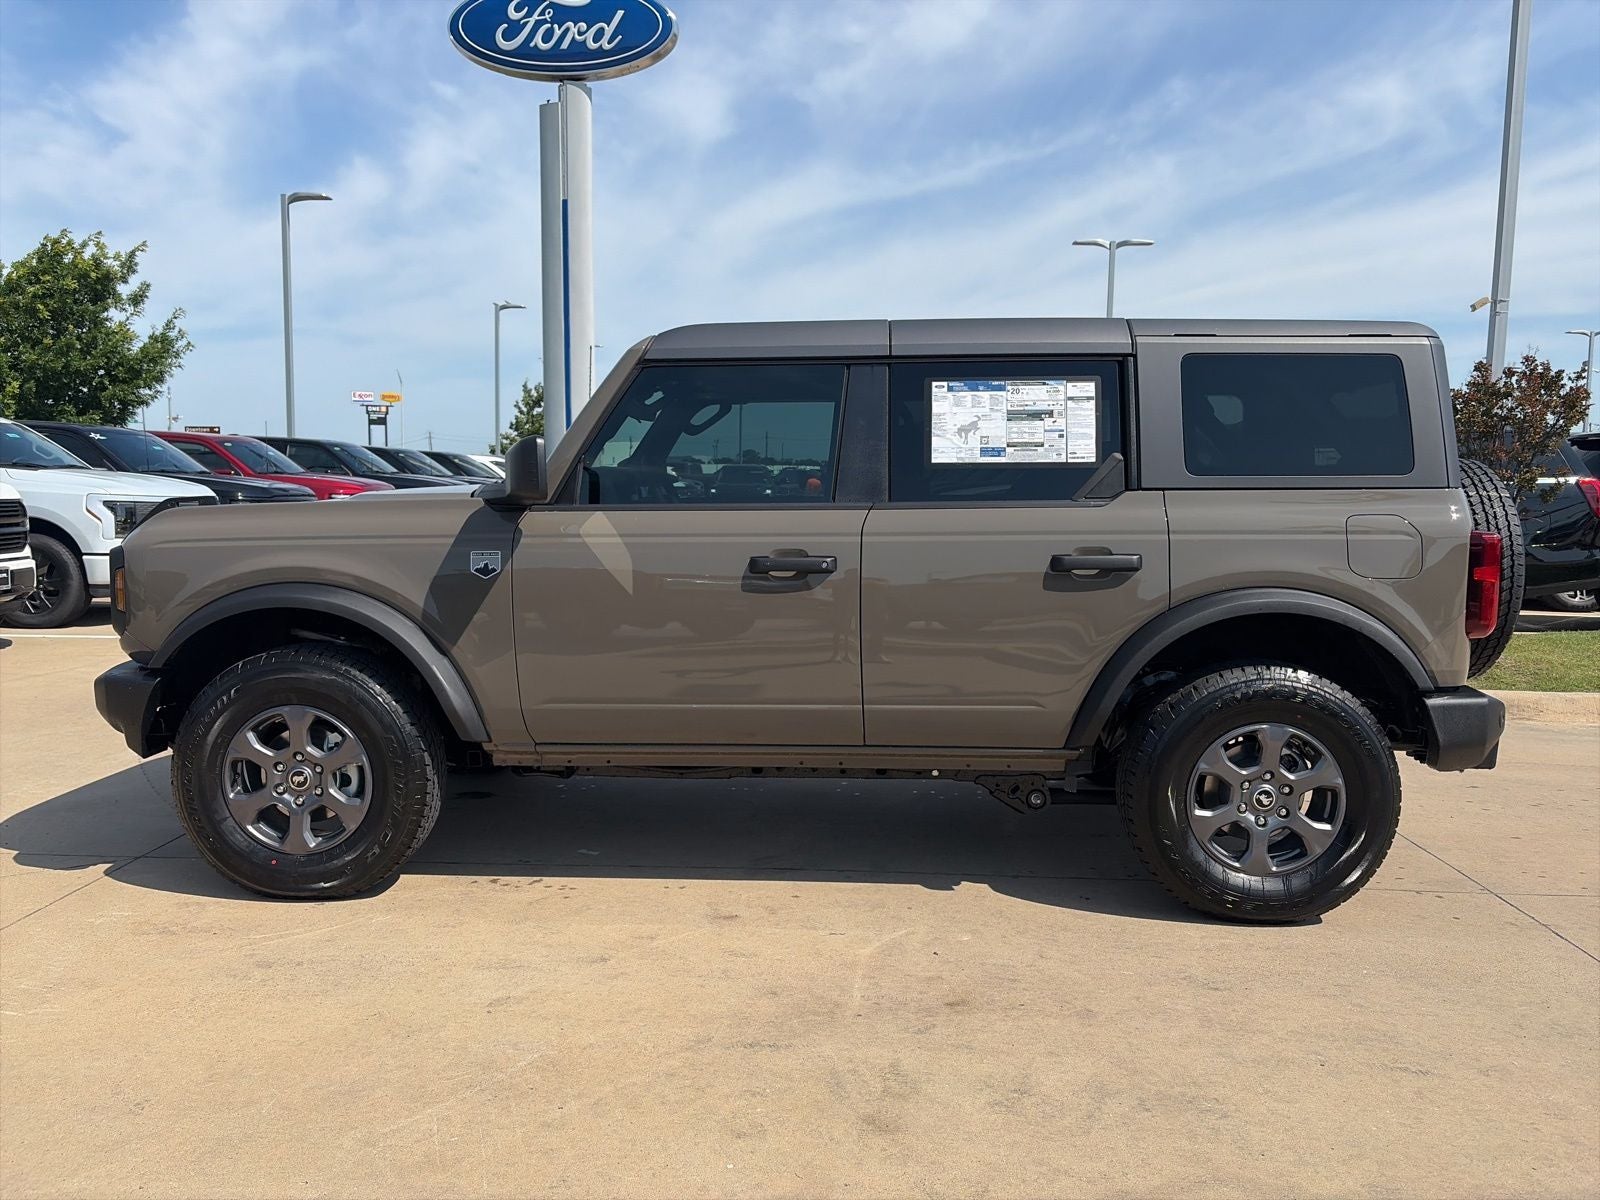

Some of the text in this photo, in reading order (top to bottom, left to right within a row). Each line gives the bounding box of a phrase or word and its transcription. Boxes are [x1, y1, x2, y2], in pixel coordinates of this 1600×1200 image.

[495, 0, 625, 51] Ford
[1010, 387, 1021, 395] 20
[353, 392, 373, 400] Exxon
